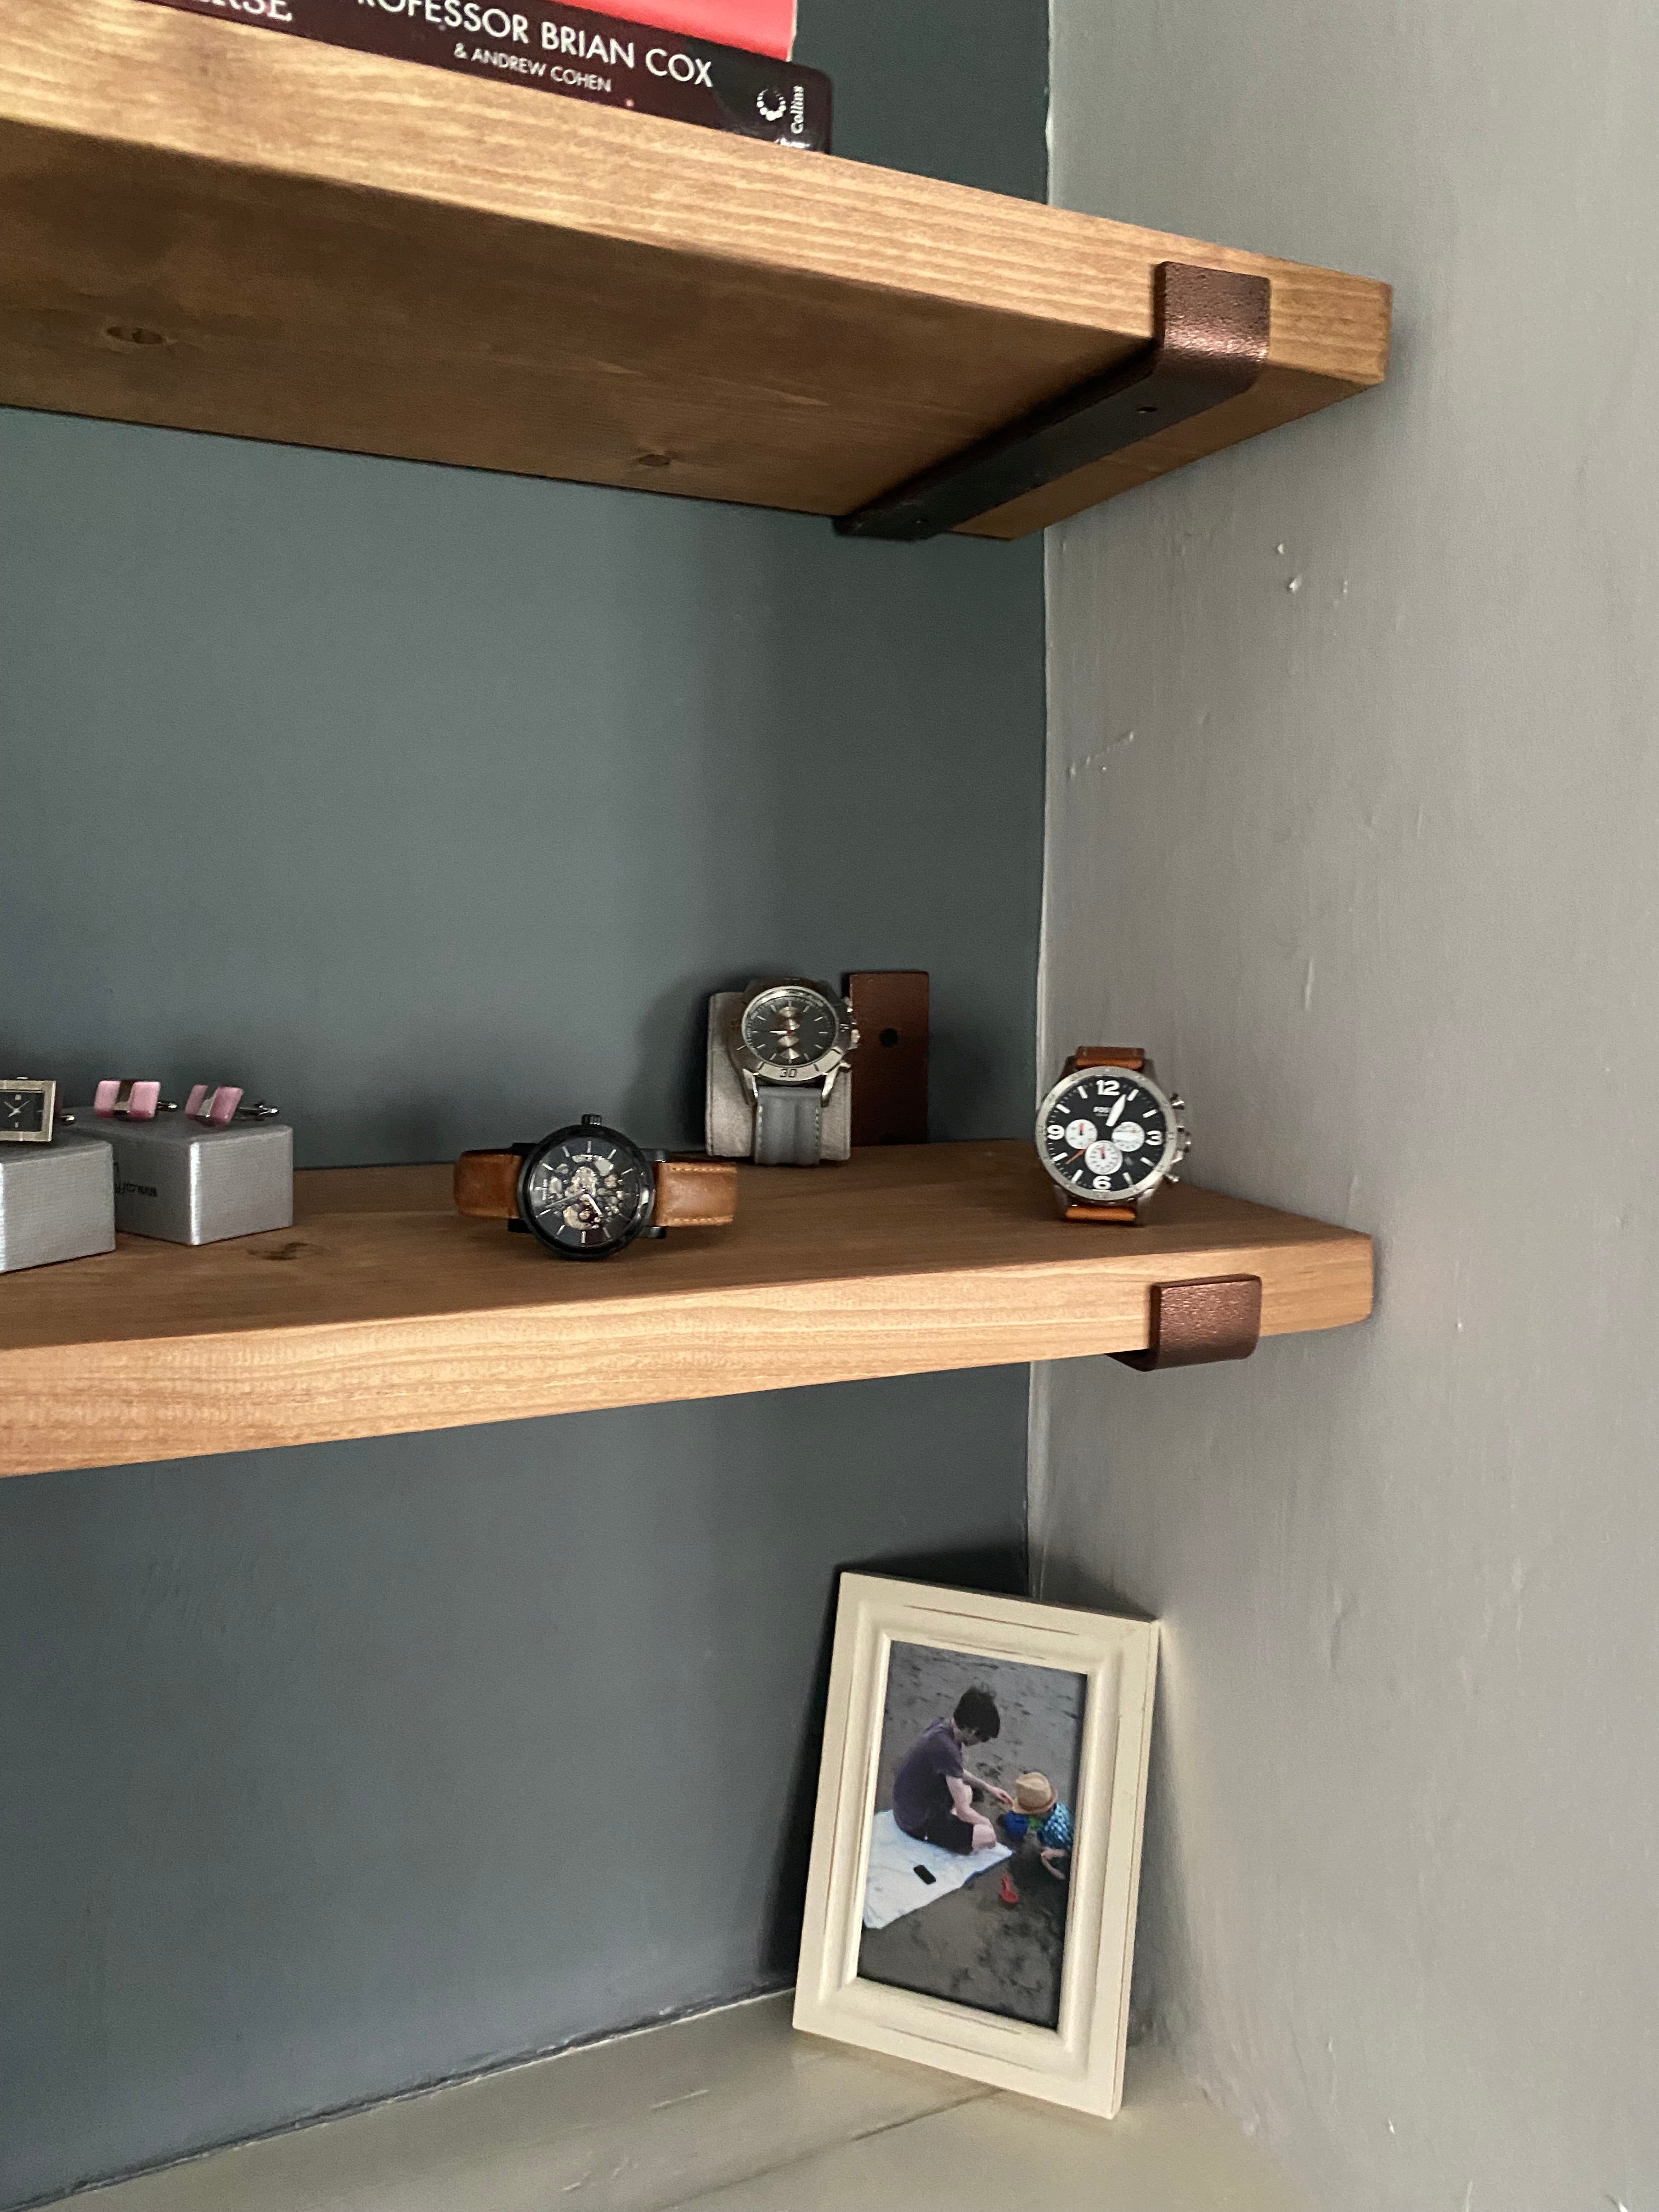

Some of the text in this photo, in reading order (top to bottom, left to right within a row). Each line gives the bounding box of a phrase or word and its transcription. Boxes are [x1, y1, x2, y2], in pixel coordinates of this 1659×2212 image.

[541, 21, 635, 69] BRIAN
[645, 48, 714, 88] COX
[453, 42, 613, 93] & ANDREW COHEN
[790, 85, 804, 134] Collins
[1096, 1080, 1120, 1096] 12
[1047, 1125, 1065, 1140] 9
[1146, 1130, 1163, 1146] 3
[1092, 1176, 1112, 1190] 6
